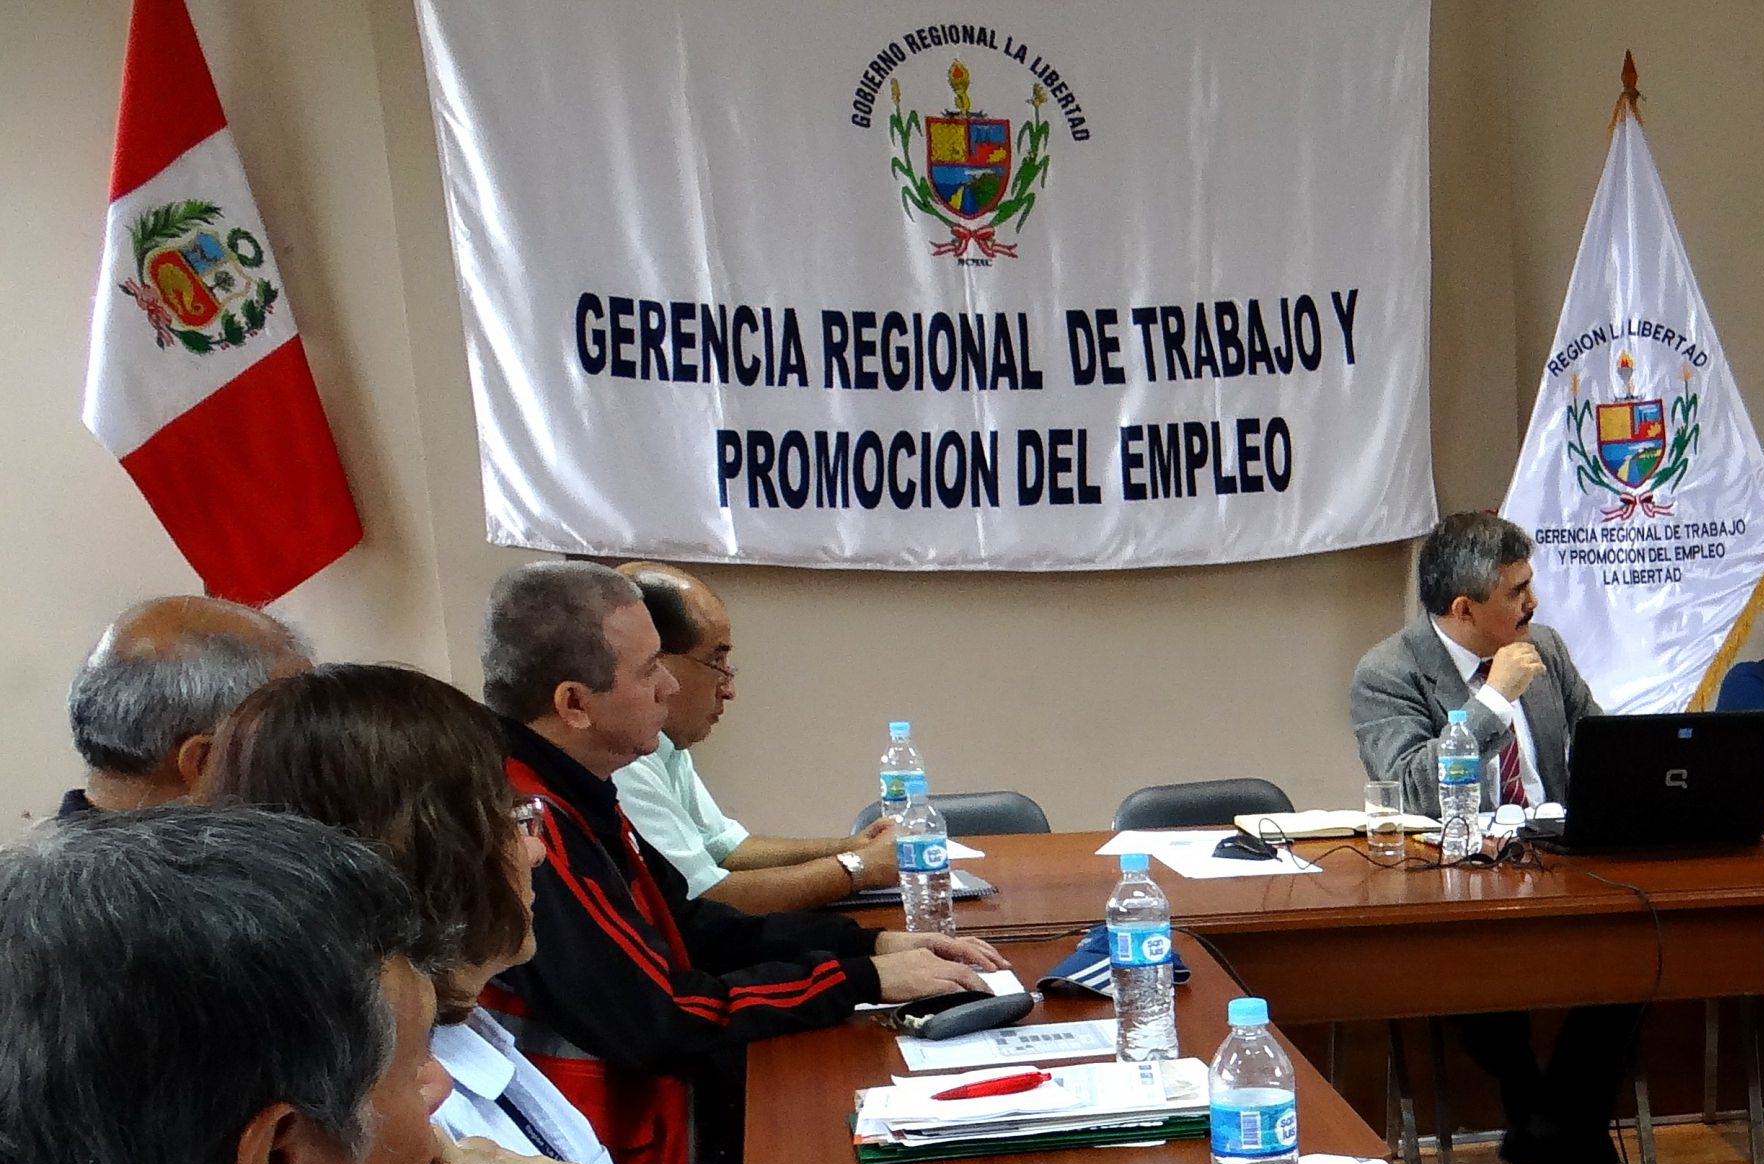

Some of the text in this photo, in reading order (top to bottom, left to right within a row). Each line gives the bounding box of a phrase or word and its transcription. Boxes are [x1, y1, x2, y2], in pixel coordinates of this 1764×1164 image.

[851, 24, 1091, 142] GOBIERNO REGIONAL LA LIBERTAD
[575, 288, 1359, 393] GERENCIA REGIONAL DE TRABAJO Y
[1547, 326, 1607, 378] REGION
[1627, 318, 1709, 369] LIBERTAD
[716, 416, 1293, 511] PROMOCION DEL EMPLEO
[1535, 518, 1747, 545] GERENCIA REGIONAL DE TRABAJO
[1558, 550, 1567, 565] Y
[1648, 546, 1672, 563] DEL
[1674, 542, 1726, 562] EMPLEO
[1603, 567, 1682, 586] LA LIBERTAD
